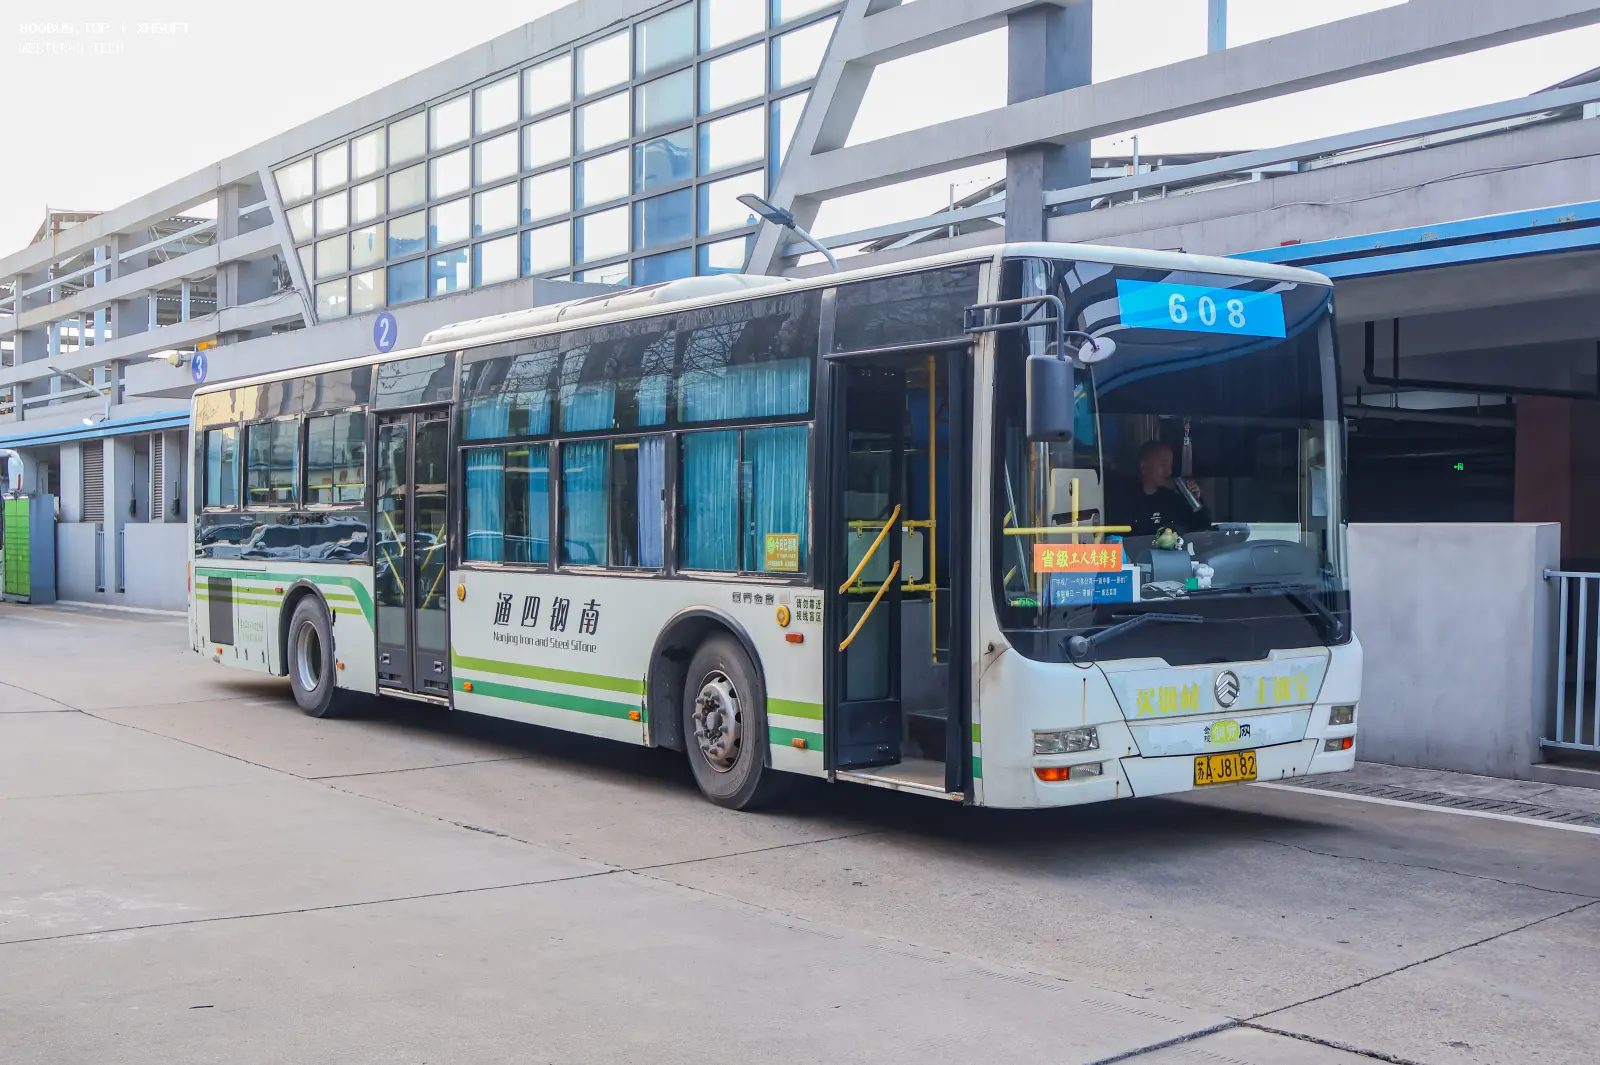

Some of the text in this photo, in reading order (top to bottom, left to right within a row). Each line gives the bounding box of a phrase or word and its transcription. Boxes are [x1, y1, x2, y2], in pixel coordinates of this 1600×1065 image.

[1168, 293, 1246, 328] 608
[379, 317, 390, 347] 2
[195, 355, 203, 379] 3
[796, 598, 821, 610] 请勿靠近
[796, 610, 821, 622] 视线盲区
[493, 631, 518, 646] Nanjing
[519, 634, 534, 645] Iron
[535, 637, 548, 647] and
[550, 637, 569, 650] Steel
